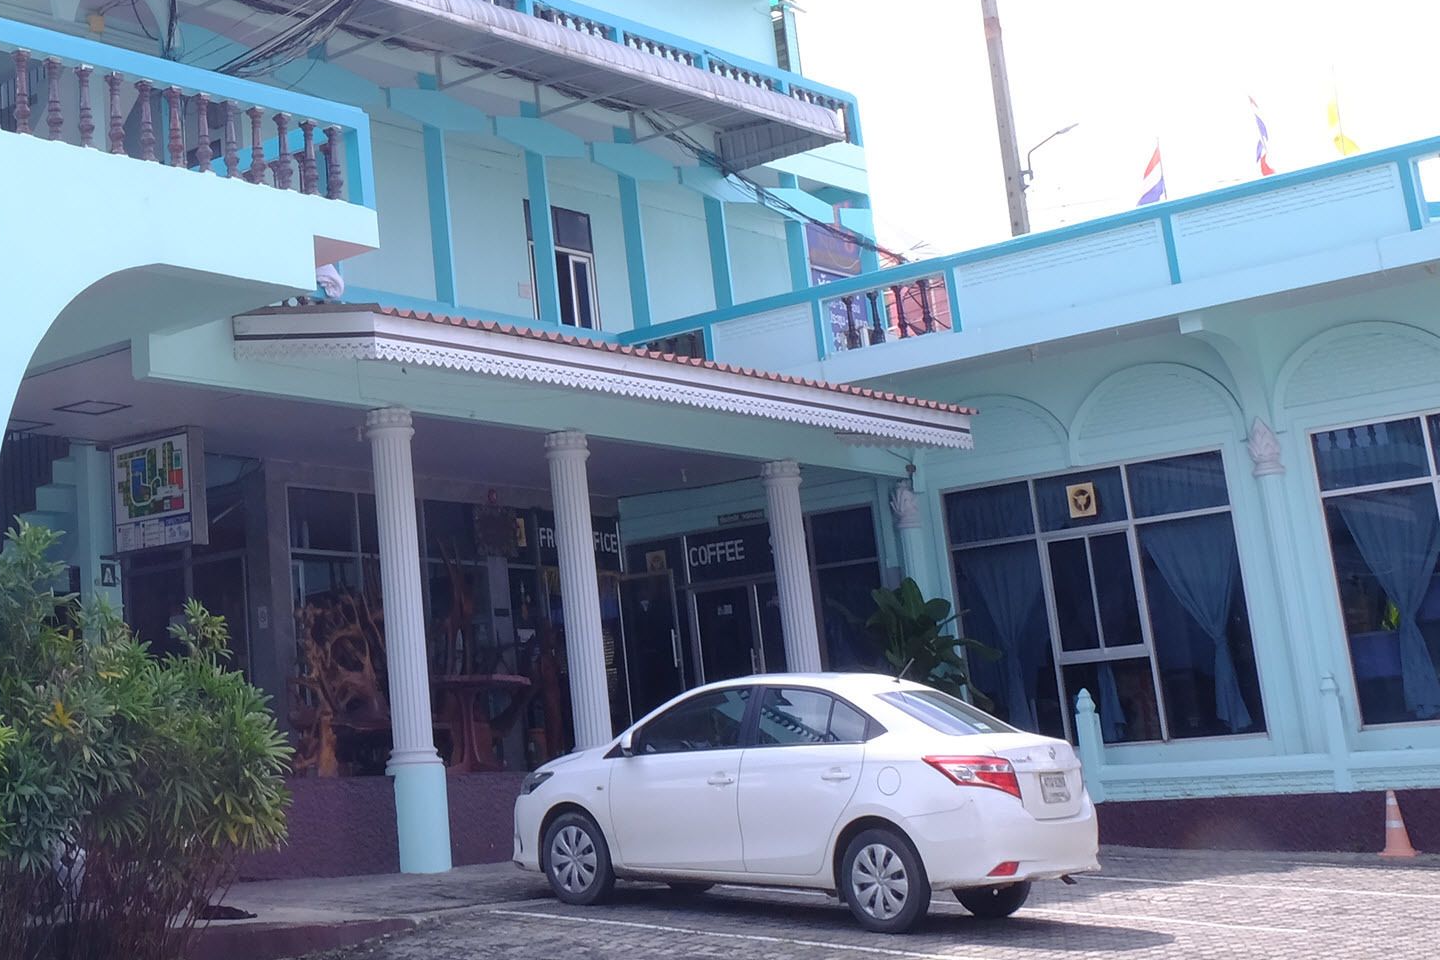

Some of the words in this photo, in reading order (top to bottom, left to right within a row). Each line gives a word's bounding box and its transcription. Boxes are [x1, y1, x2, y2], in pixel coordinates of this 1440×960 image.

[592, 531, 618, 553] FICE
[689, 539, 745, 567] COFFEE
[103, 567, 115, 584] A
